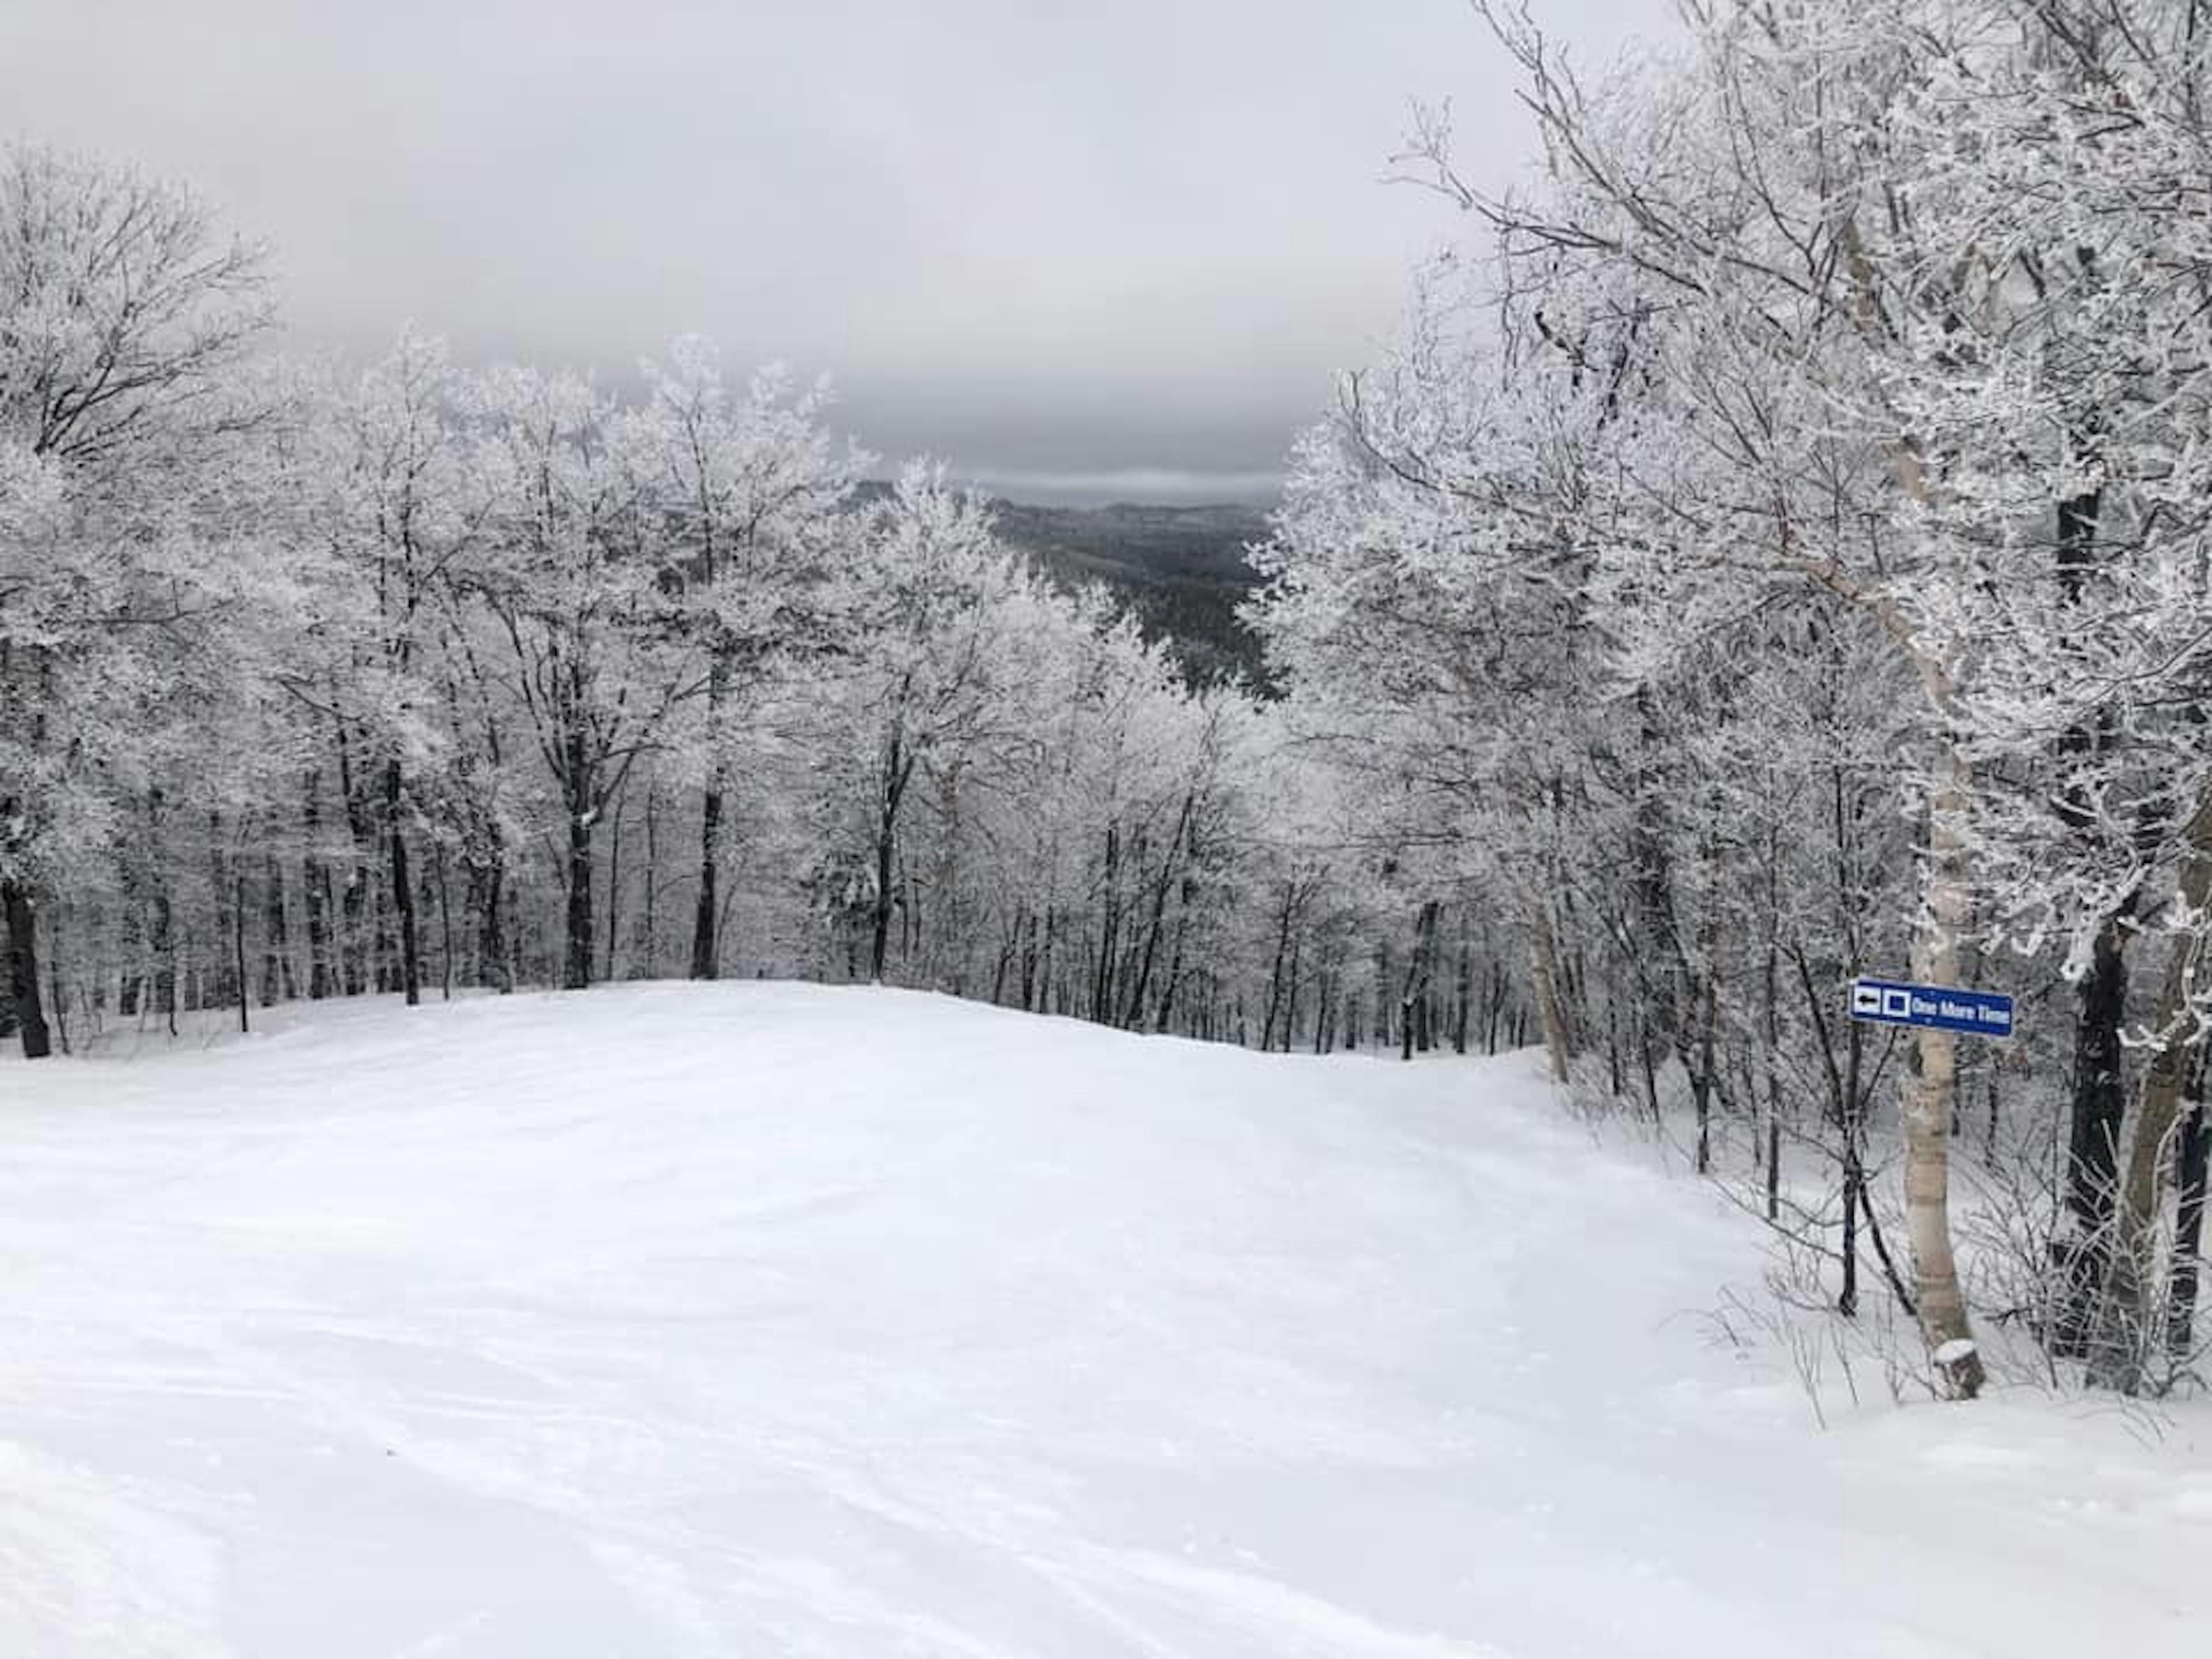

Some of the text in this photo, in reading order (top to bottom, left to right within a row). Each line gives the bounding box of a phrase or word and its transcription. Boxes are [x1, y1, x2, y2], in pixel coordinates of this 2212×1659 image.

[1912, 997, 2010, 1024] One More Time
